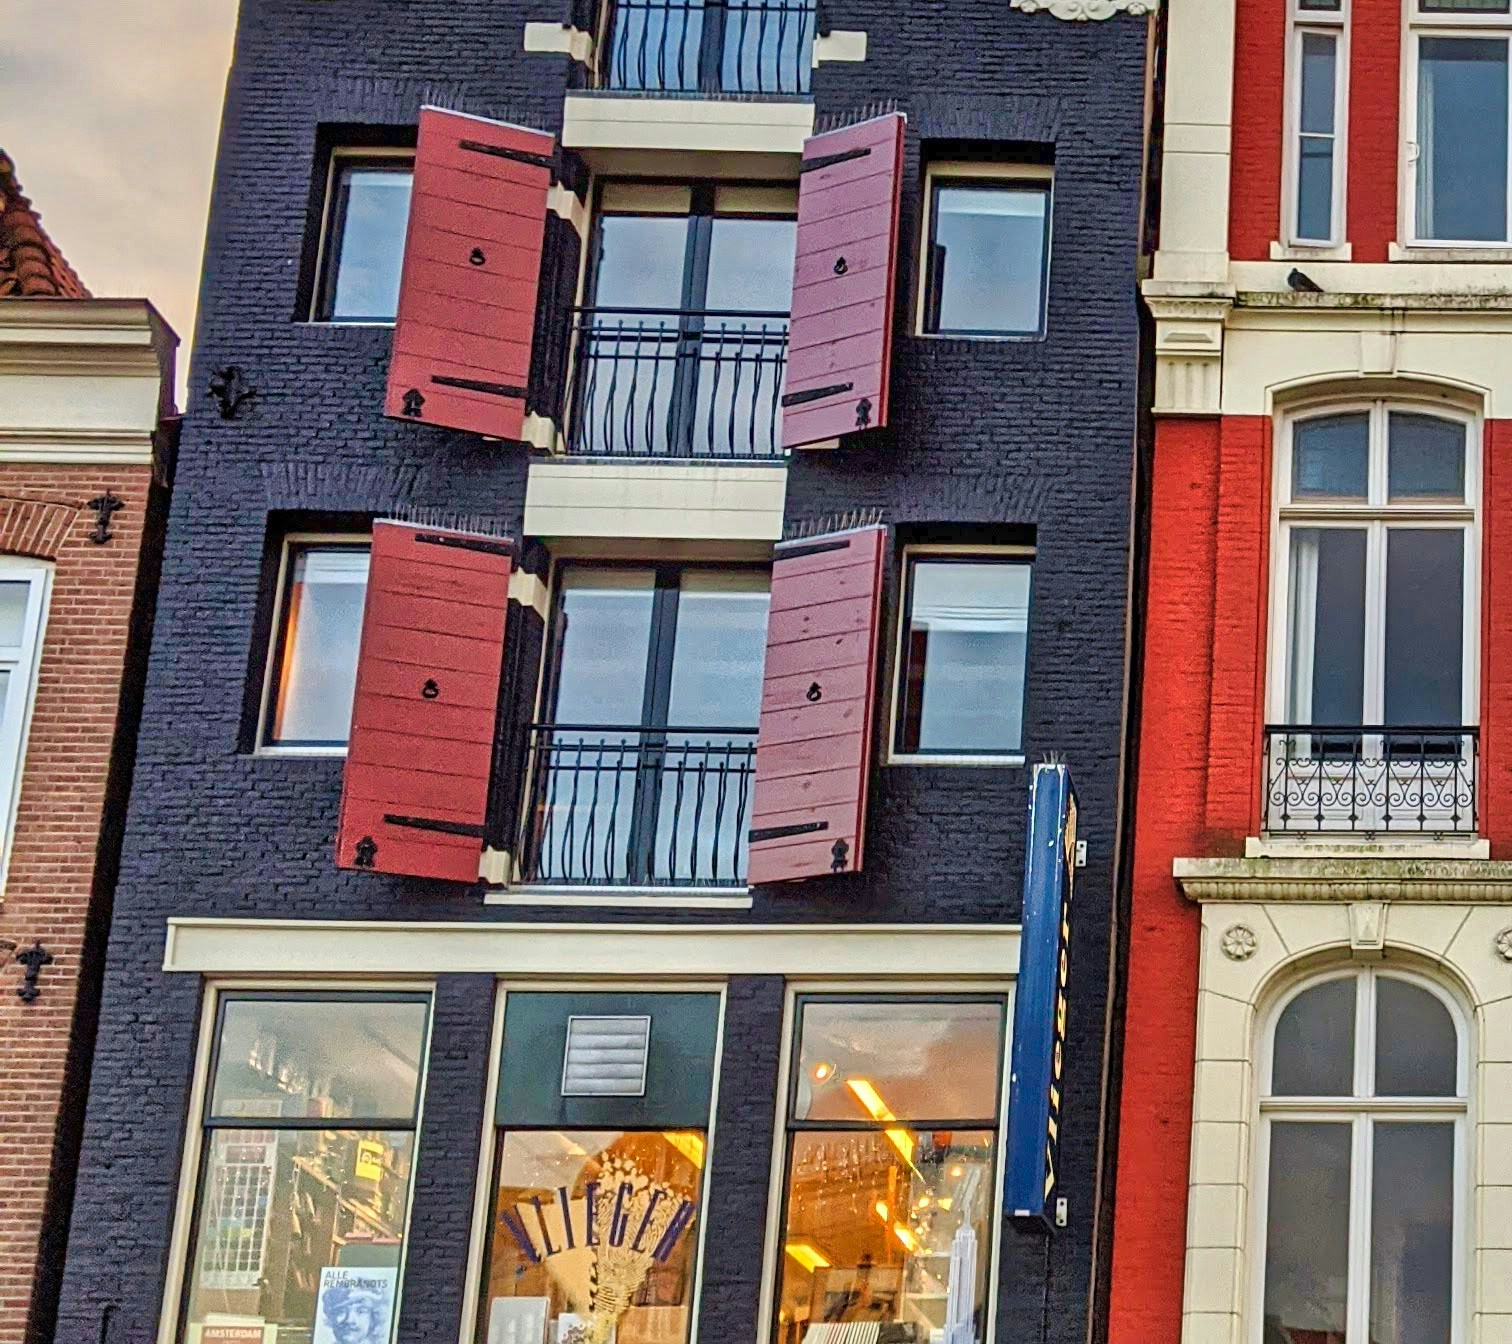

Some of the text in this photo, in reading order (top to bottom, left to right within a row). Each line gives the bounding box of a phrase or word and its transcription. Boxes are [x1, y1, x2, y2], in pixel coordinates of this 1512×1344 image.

[500, 1181, 697, 1264] VLIEGER
[325, 1270, 349, 1280] ALLE
[323, 1278, 388, 1289] REMBRANDTS
[204, 1328, 262, 1339] AMSTERDAM
